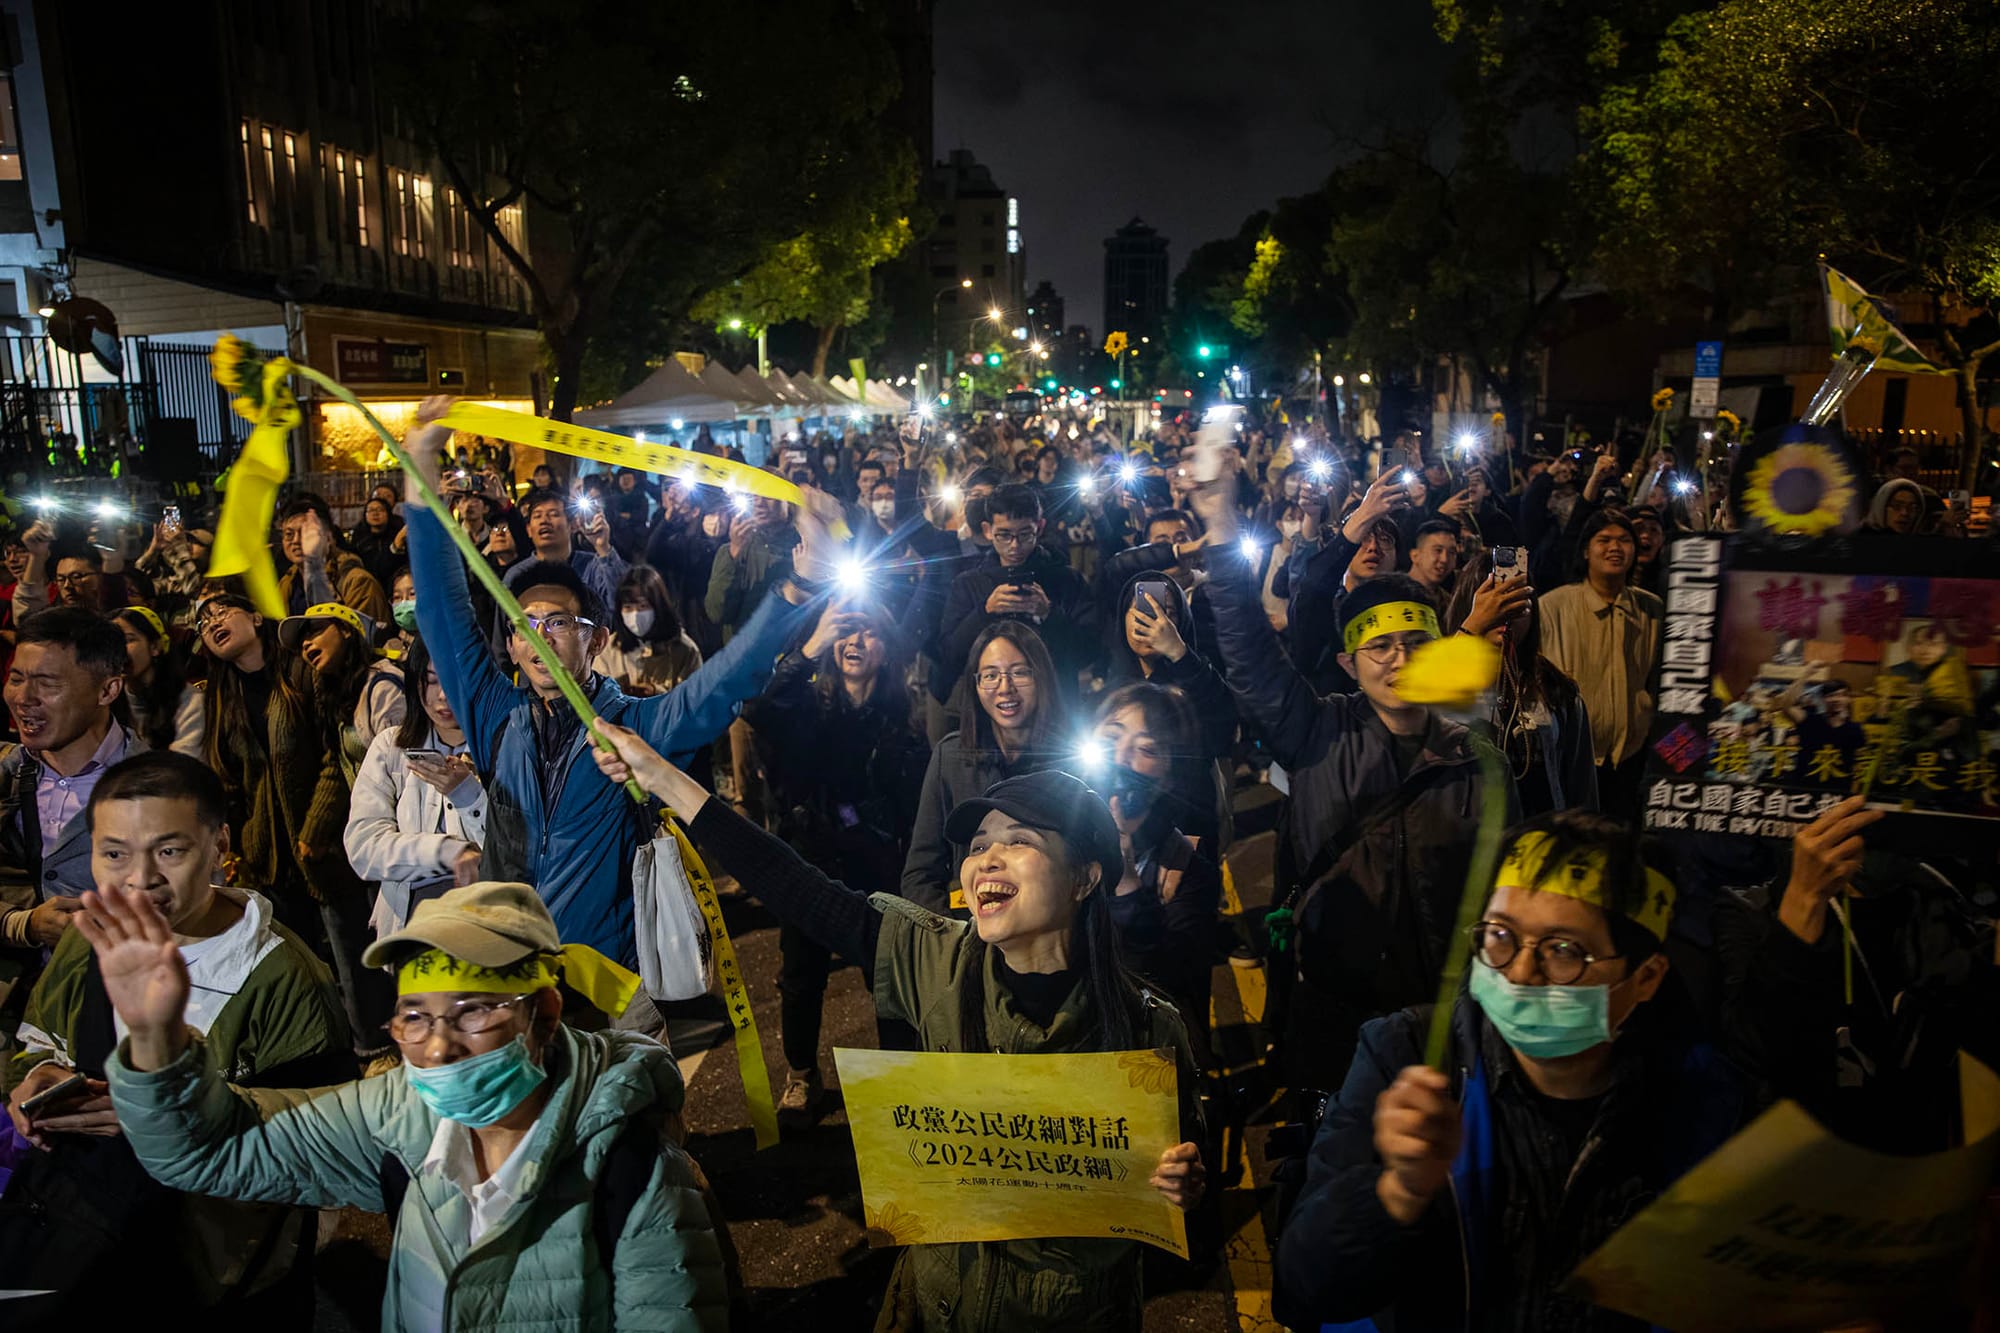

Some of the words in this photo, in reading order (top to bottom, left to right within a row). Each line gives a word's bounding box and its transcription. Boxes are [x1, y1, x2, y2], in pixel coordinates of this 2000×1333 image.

[892, 1104, 1130, 1151] 政黨公民政綱對話
[907, 1138, 1130, 1182] 《2024公民政綱》
